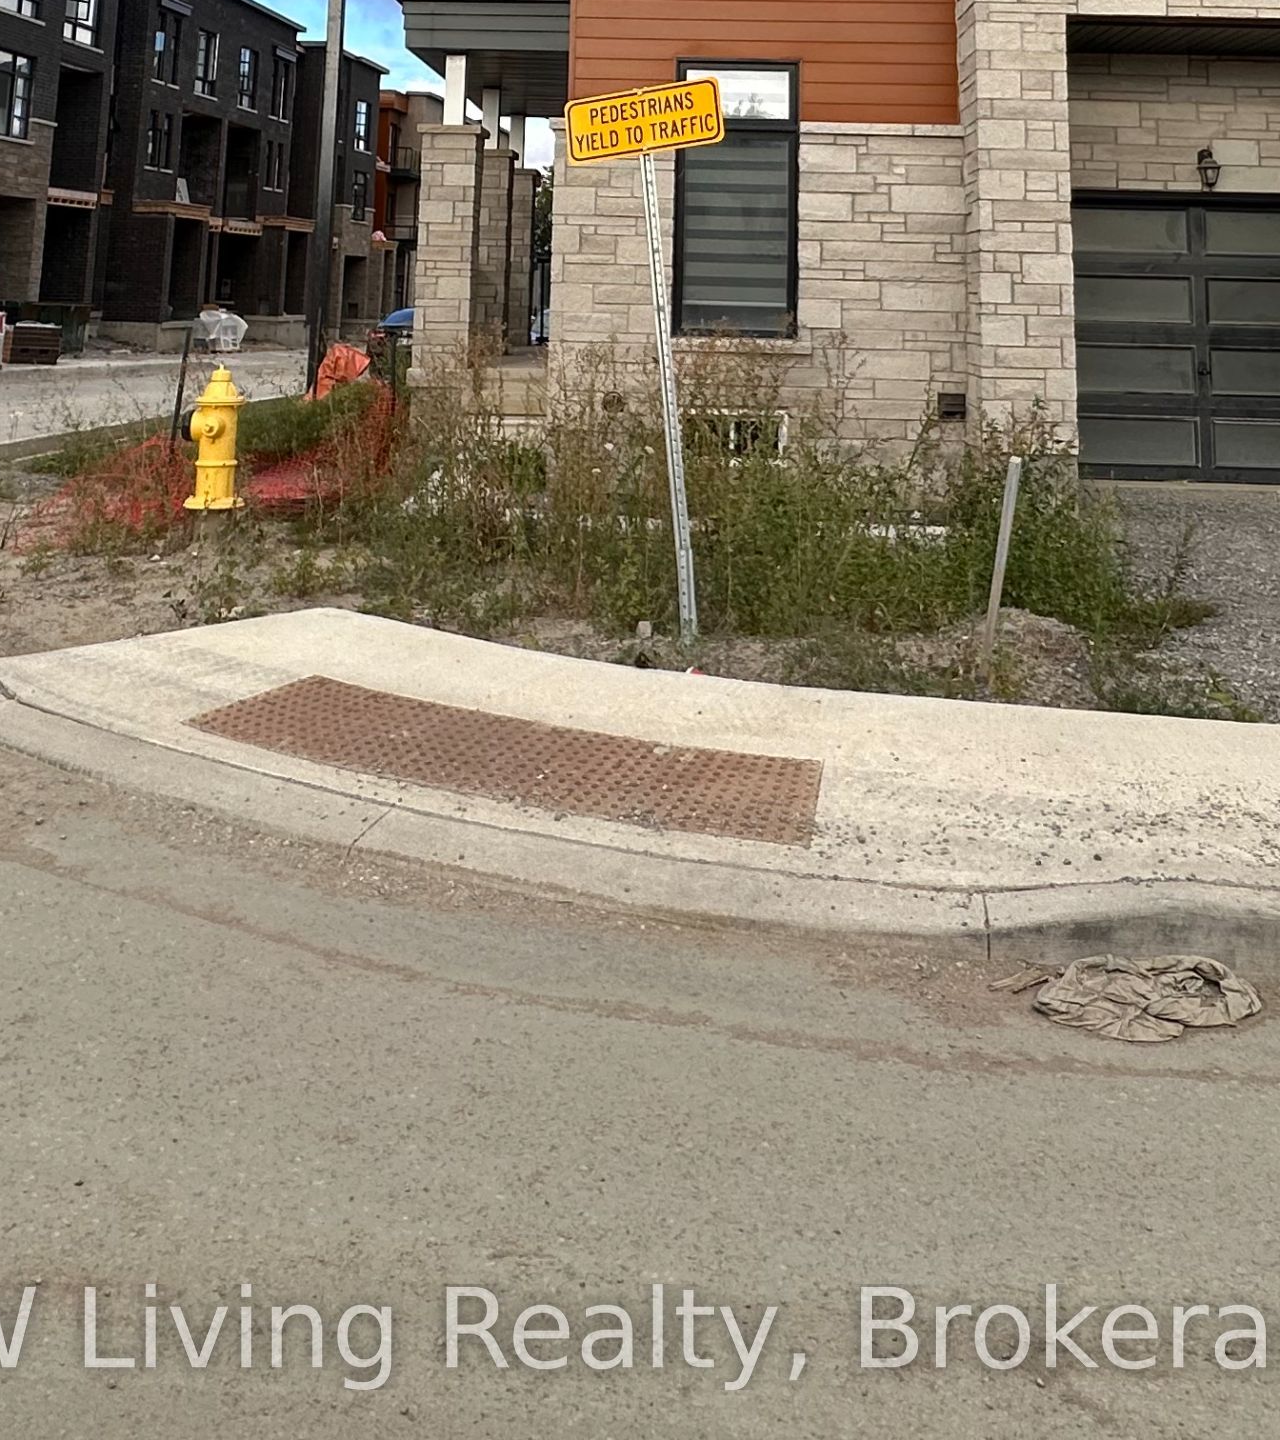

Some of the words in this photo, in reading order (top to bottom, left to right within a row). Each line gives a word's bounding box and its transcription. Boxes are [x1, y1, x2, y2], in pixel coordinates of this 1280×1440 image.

[590, 91, 694, 126] PEDESTRIANS
[575, 129, 619, 153] YIELD
[625, 125, 643, 144] TO
[651, 113, 715, 141] TRAFFIC
